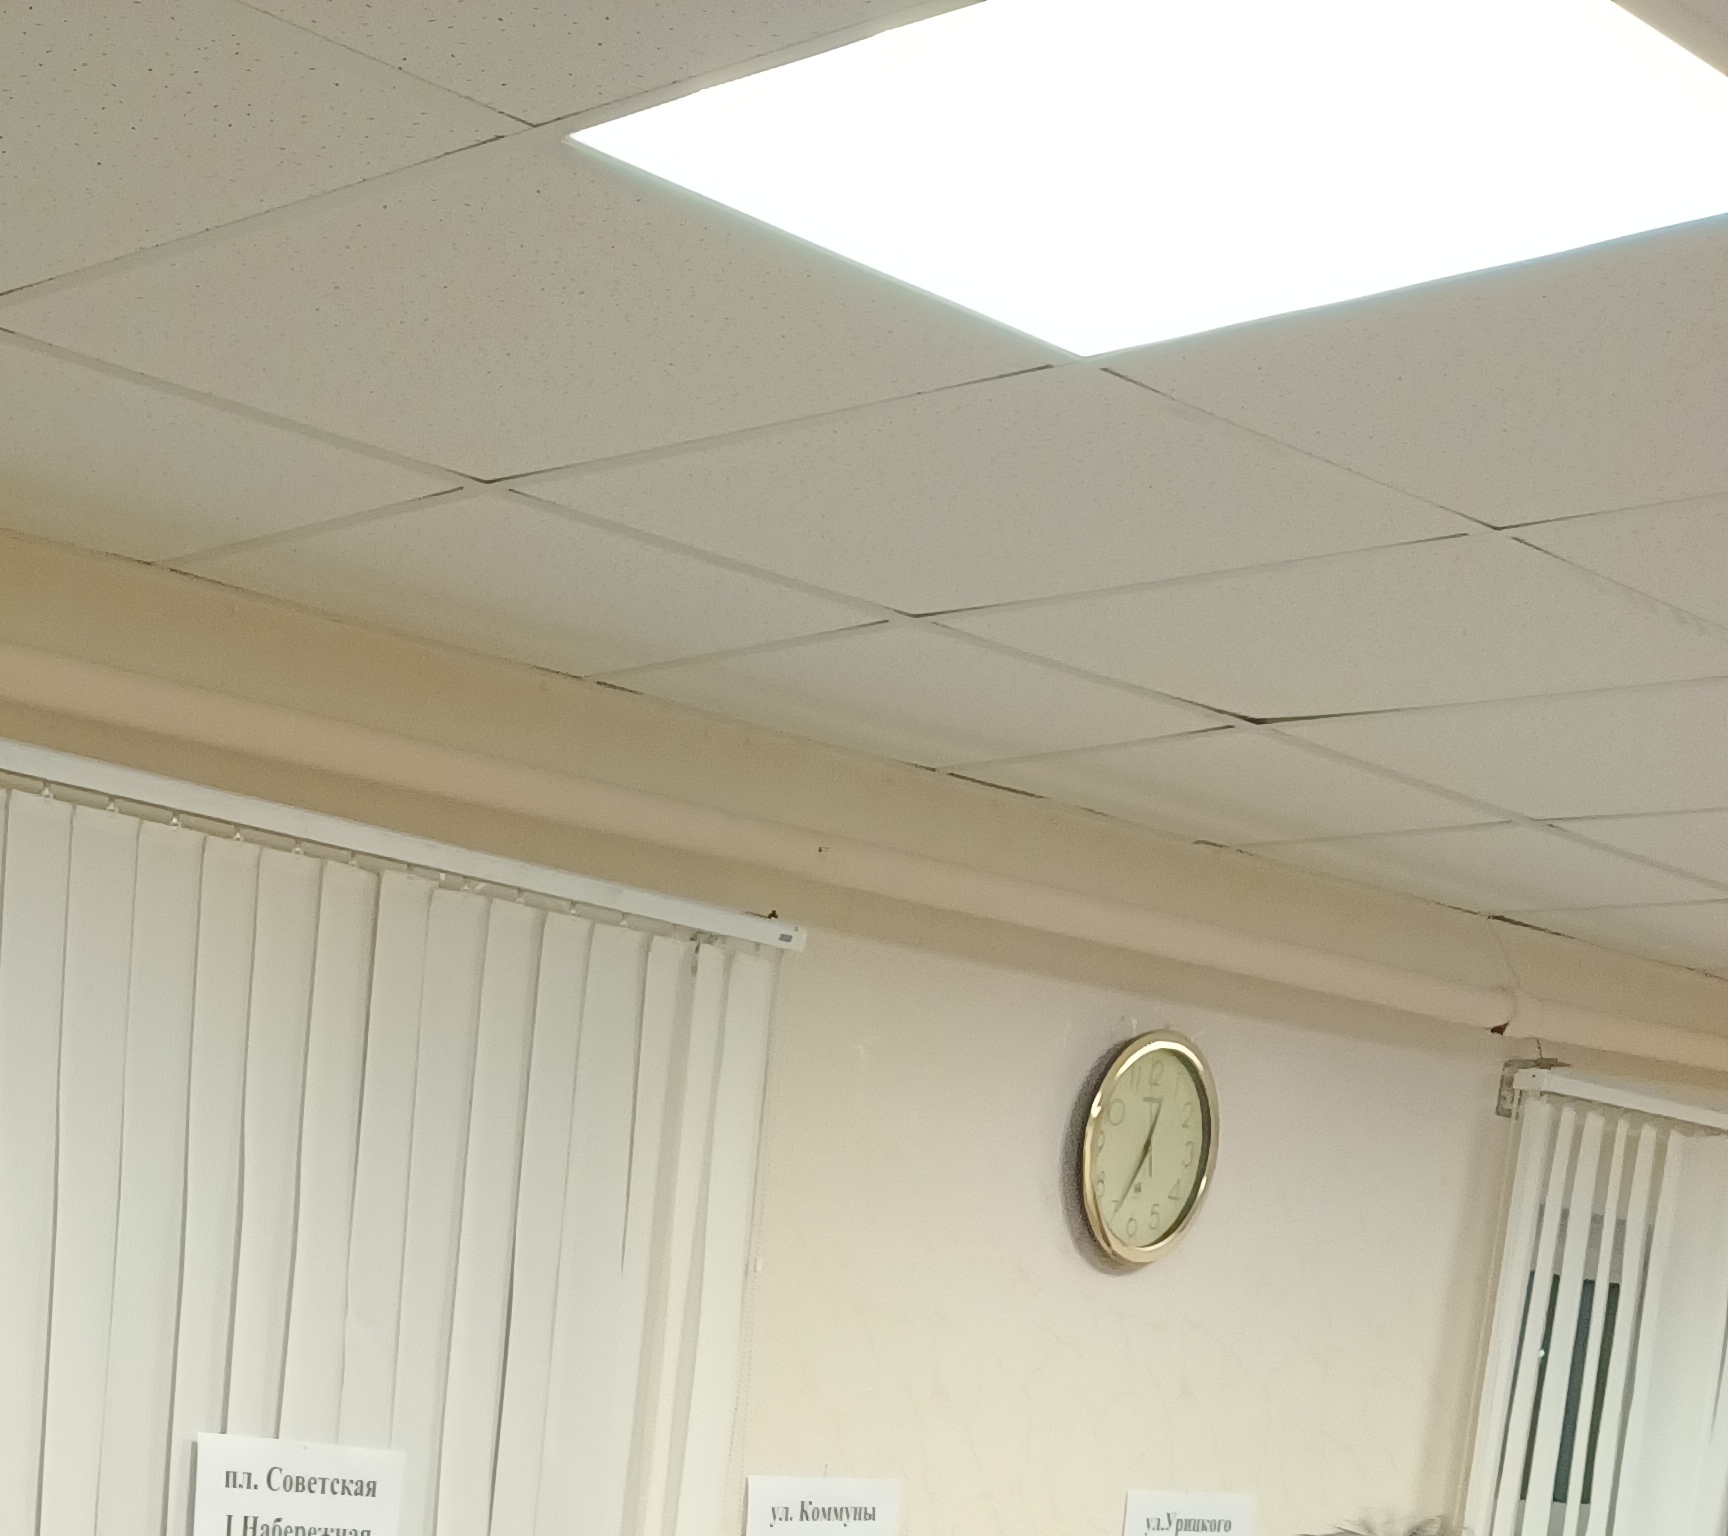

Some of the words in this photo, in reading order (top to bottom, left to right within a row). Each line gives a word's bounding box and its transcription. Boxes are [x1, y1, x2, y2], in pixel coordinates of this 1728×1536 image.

[1182, 1102, 1195, 1129] 2
[1182, 1141, 1196, 1168] 3
[1168, 1178, 1183, 1201] 4
[1148, 1203, 1160, 1230] 5
[224, 1470, 259, 1490] пл.
[266, 1466, 377, 1498] Советская
[769, 1506, 794, 1527] ул.
[799, 1500, 876, 1527] Коммуны
